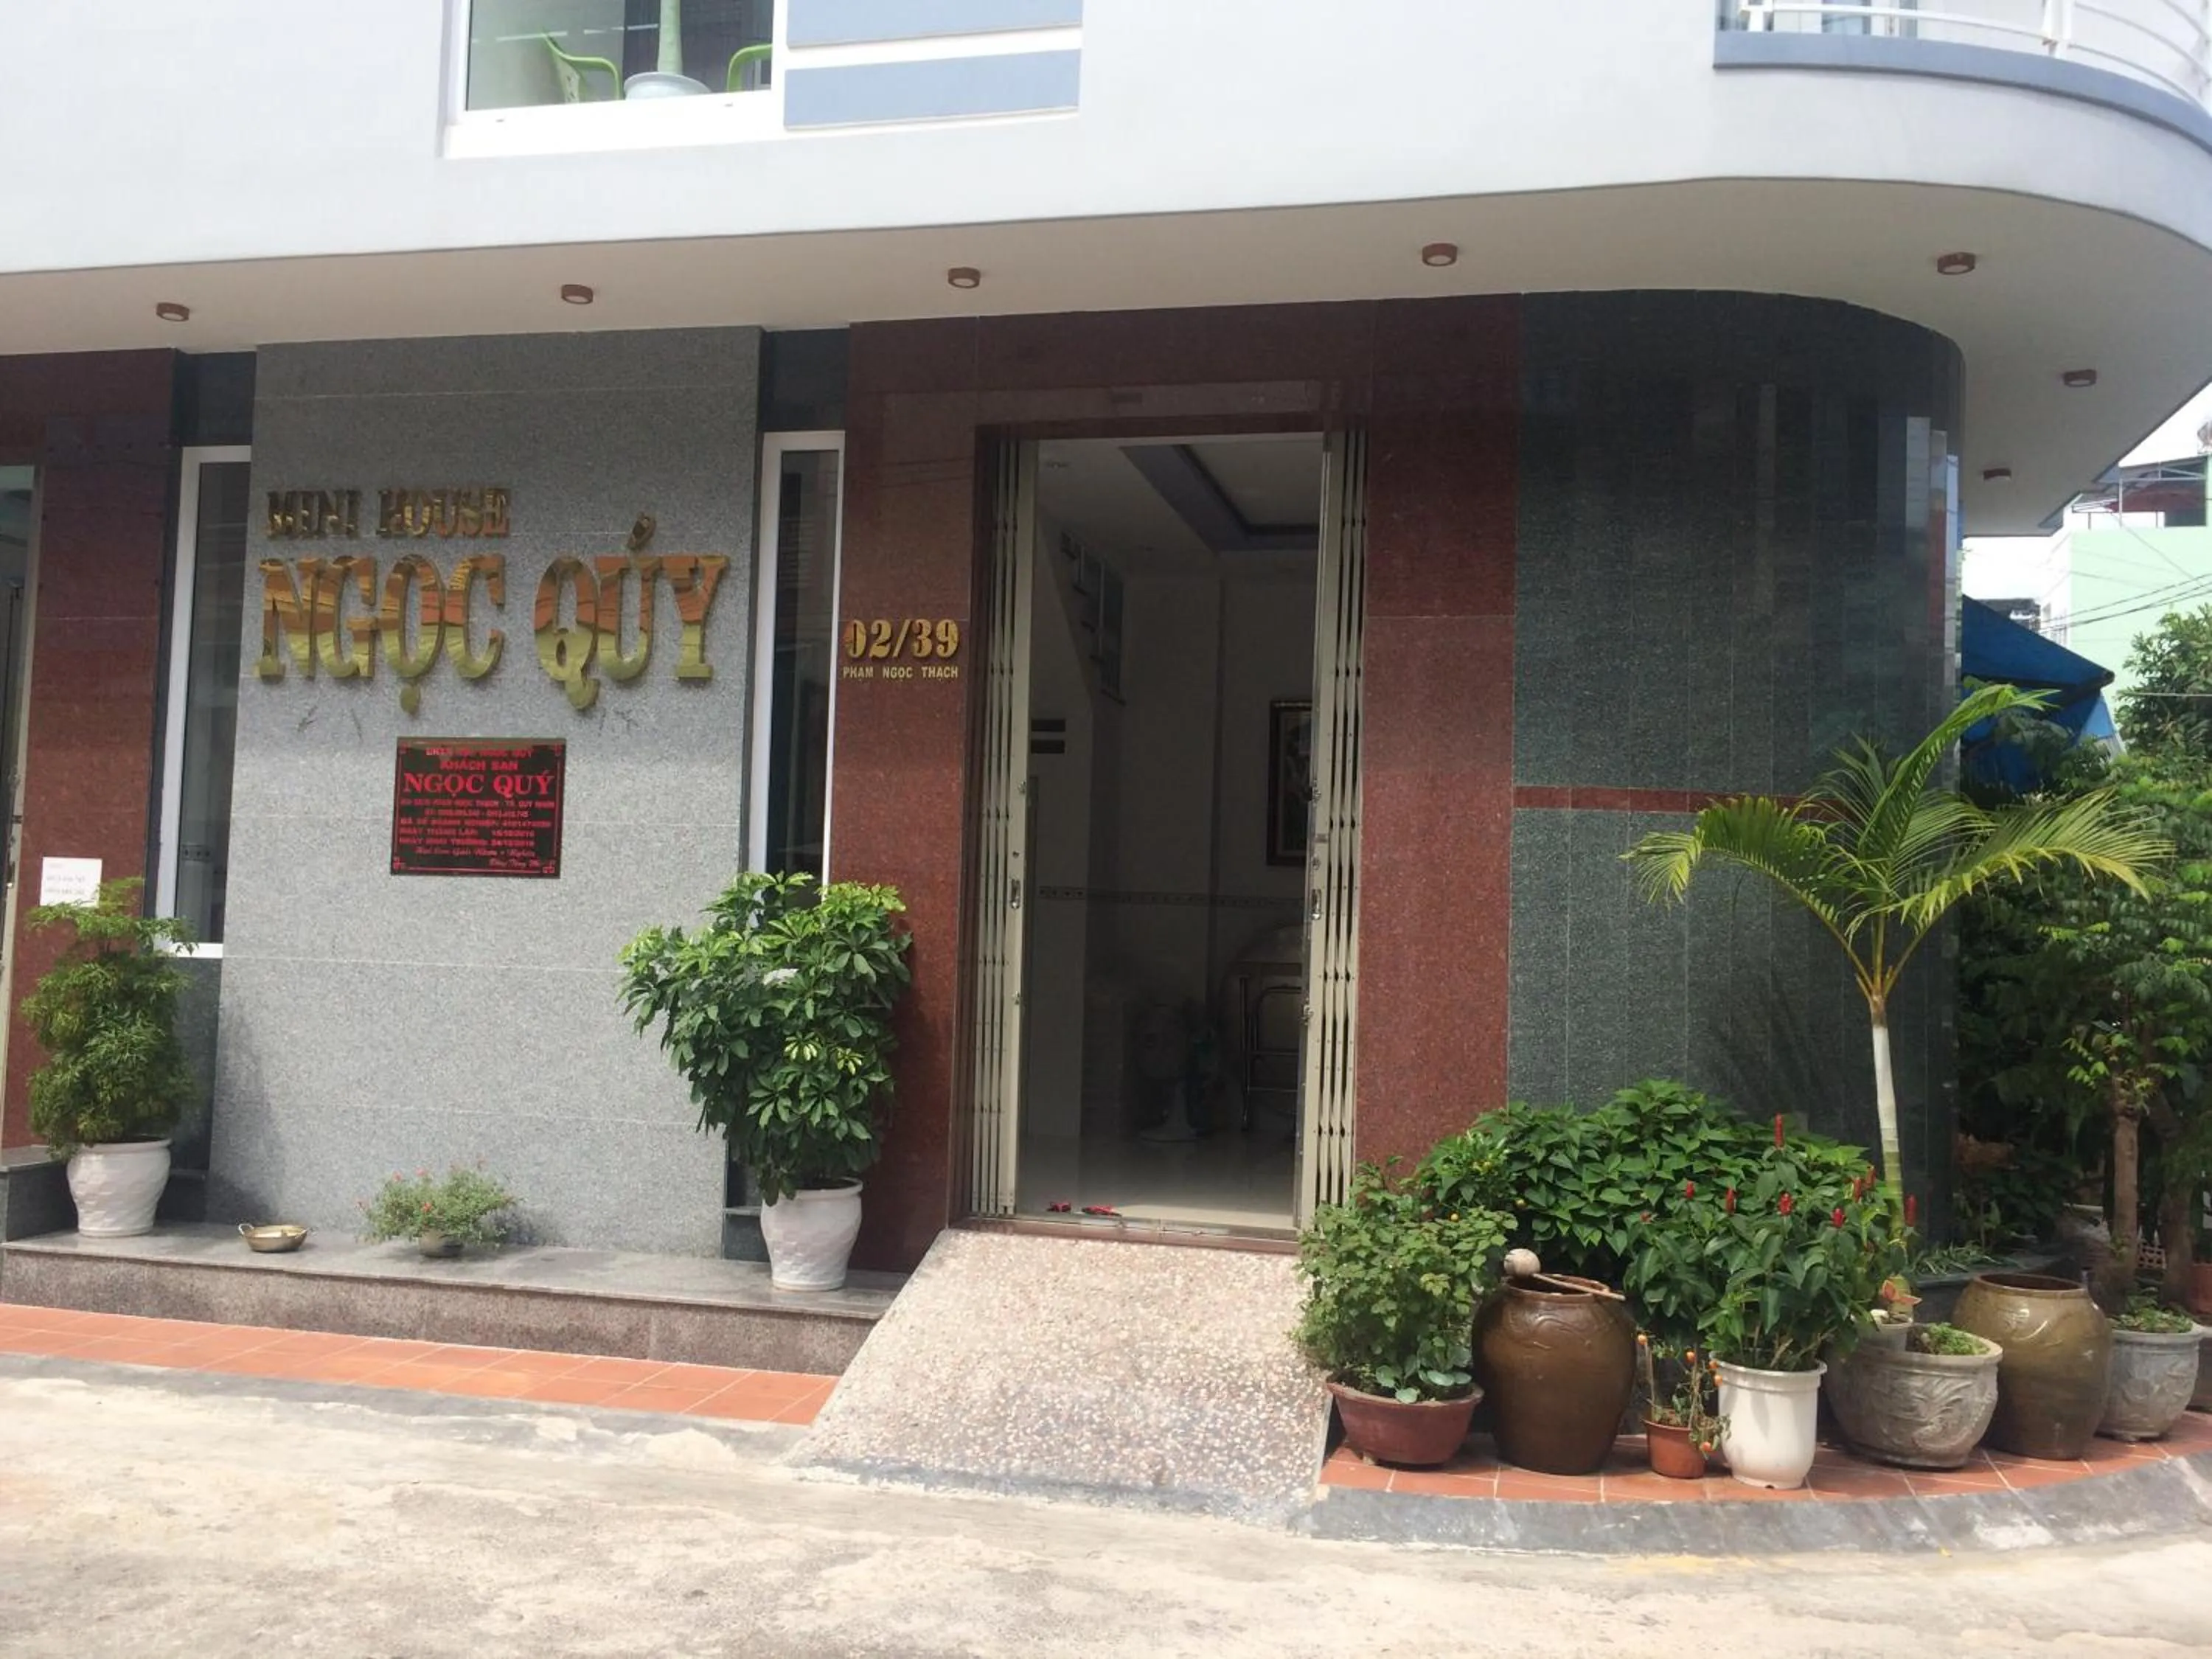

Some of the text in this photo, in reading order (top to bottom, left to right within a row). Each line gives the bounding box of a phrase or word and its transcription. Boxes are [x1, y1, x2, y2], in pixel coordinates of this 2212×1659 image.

[266, 487, 511, 539] MINI HOUSE
[844, 618, 959, 658] 02/39
[403, 769, 555, 799] NGỌC QUÝ
